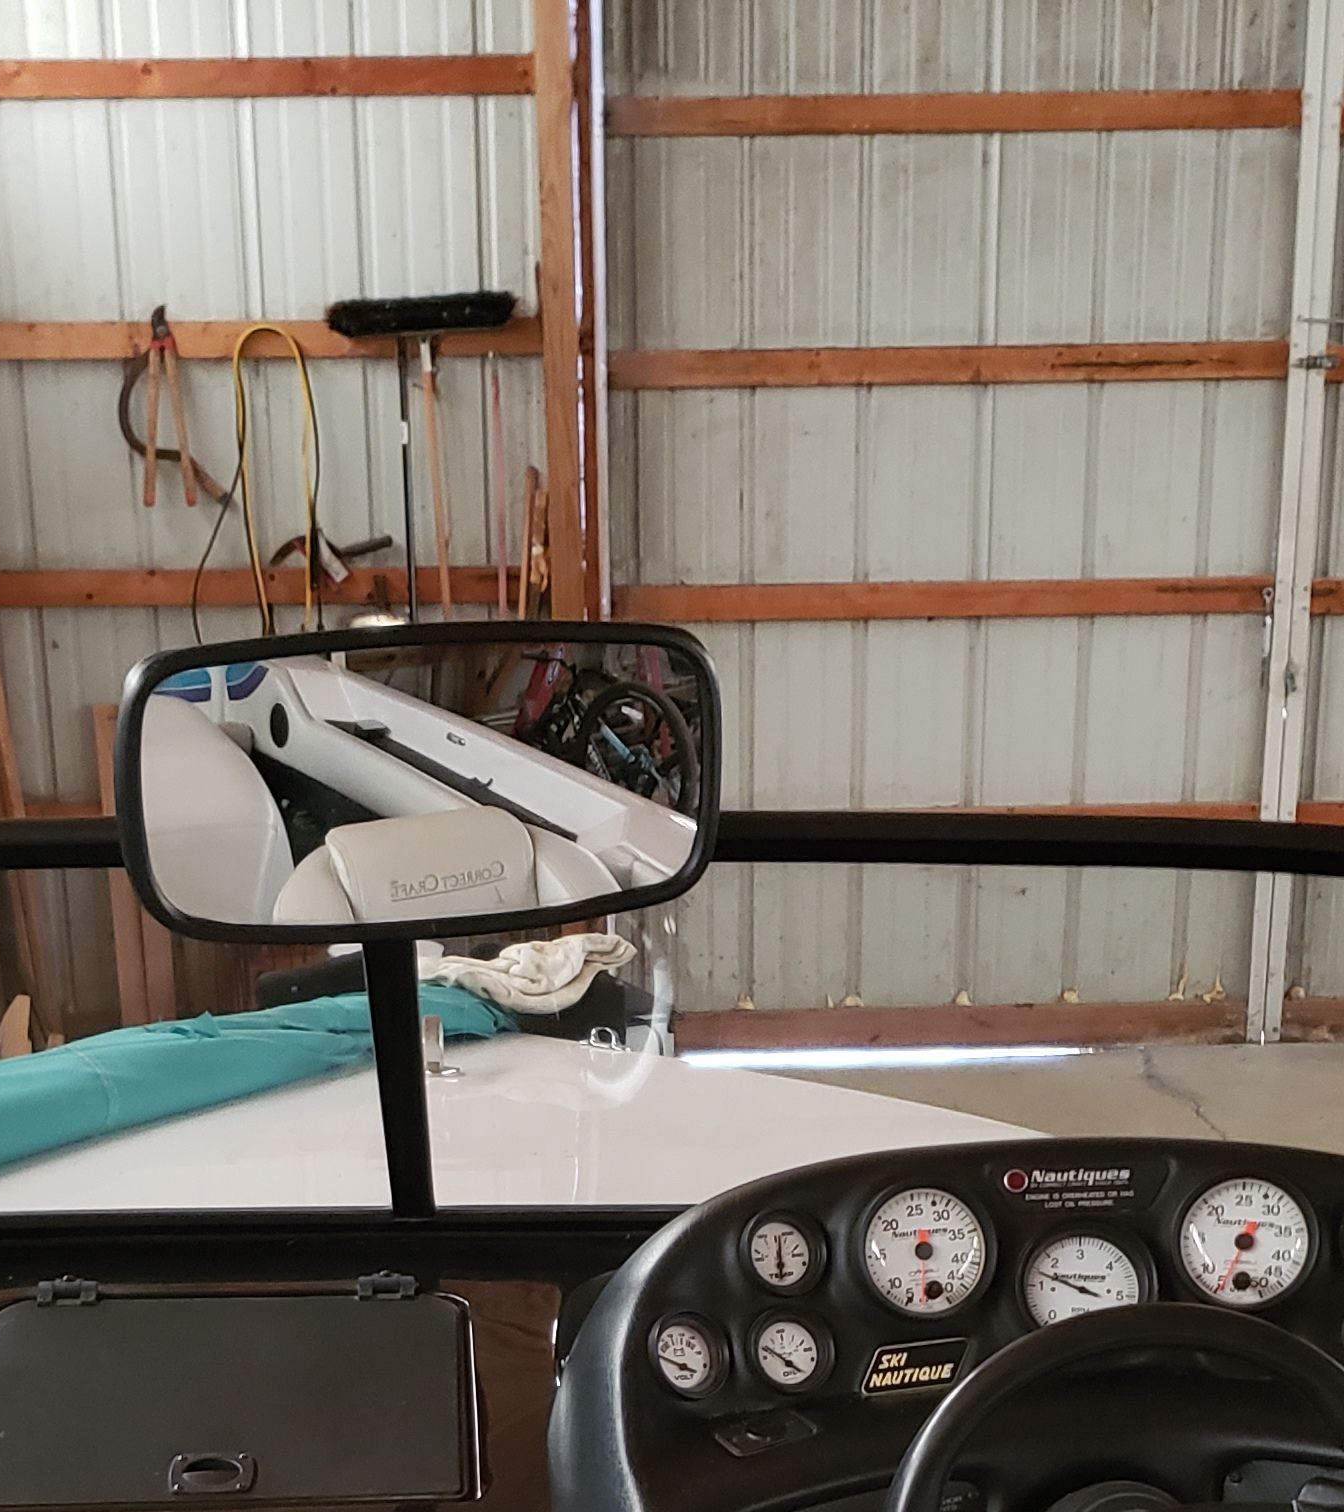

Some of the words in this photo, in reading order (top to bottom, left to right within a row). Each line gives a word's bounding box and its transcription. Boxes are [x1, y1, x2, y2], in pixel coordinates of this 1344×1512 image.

[1031, 1168, 1130, 1186] Nautiques
[1235, 1195, 1253, 1207] 25
[906, 1204, 923, 1217] 25
[933, 1209, 950, 1222] 30
[1207, 1204, 1225, 1217] 20
[1262, 1204, 1281, 1216] 30
[882, 1218, 899, 1232] 20
[948, 1228, 965, 1241] 35
[1274, 1225, 1292, 1238] 35
[951, 1252, 969, 1264] 40
[1076, 1249, 1085, 1260] 3
[1272, 1249, 1291, 1261] 40
[1051, 1257, 1059, 1269] 2
[1105, 1261, 1113, 1271] 4
[1201, 1263, 1216, 1275] 10
[947, 1269, 965, 1281] 45
[1264, 1265, 1283, 1278] 45
[888, 1277, 902, 1289] 10
[1250, 1276, 1269, 1288] 50
[1116, 1290, 1124, 1301] 5
[1048, 1309, 1057, 1320] 0
[878, 1351, 909, 1370] SKI
[869, 1362, 955, 1389] NAUTIQUE
